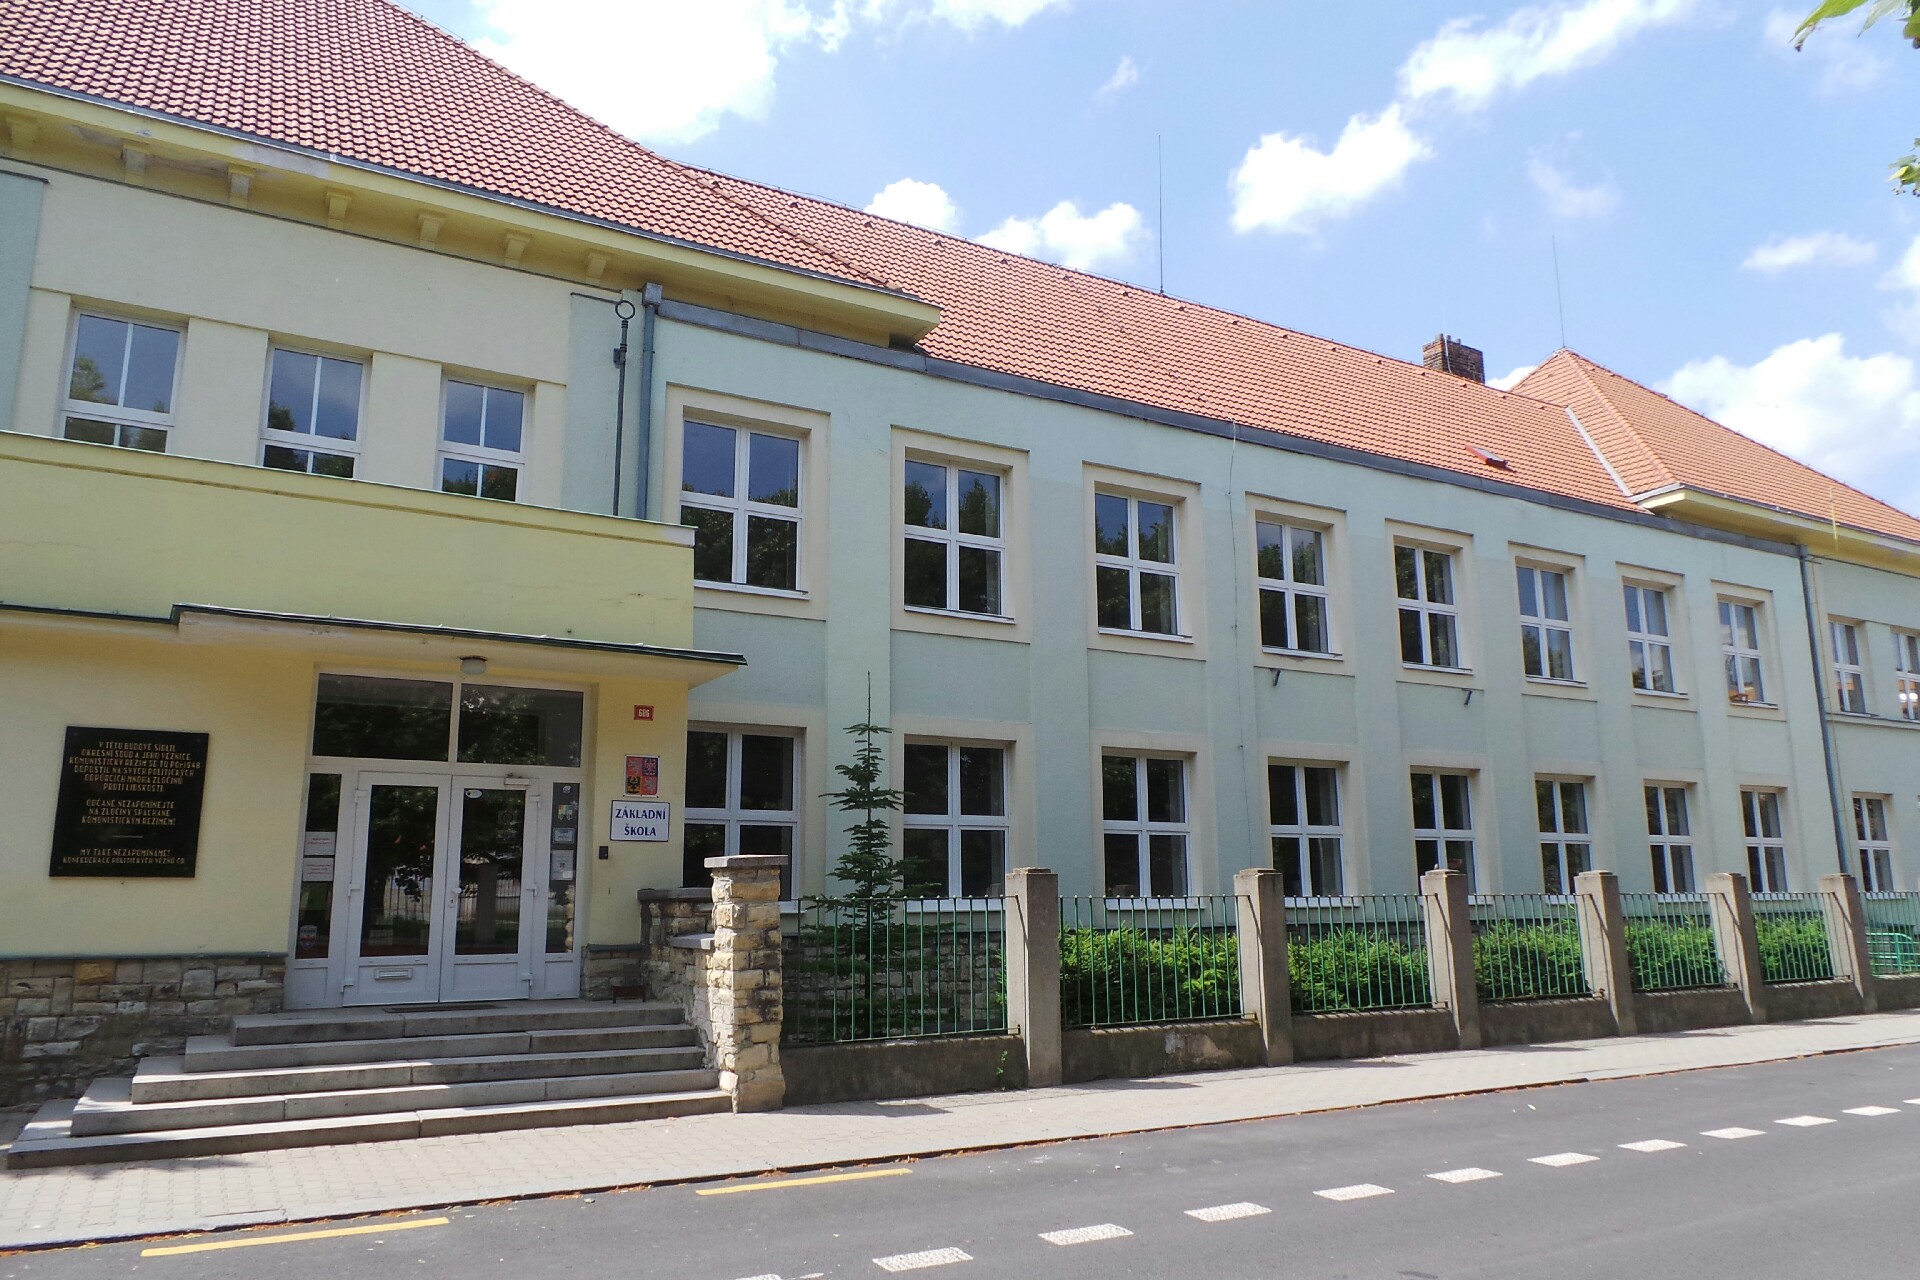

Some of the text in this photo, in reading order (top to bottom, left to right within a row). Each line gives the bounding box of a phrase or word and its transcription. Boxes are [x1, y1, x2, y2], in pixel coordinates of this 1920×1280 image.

[114, 750, 133, 758] SOUD
[142, 751, 160, 759] JEHO
[148, 759, 157, 767] SE
[159, 760, 168, 768] TU
[112, 766, 121, 774] NA
[103, 782, 124, 791] PROTI
[89, 807, 98, 815] NA
[615, 806, 666, 819] ZÁKLADNÍ
[624, 823, 656, 836] ŠKOLA
[80, 848, 90, 856] MY
